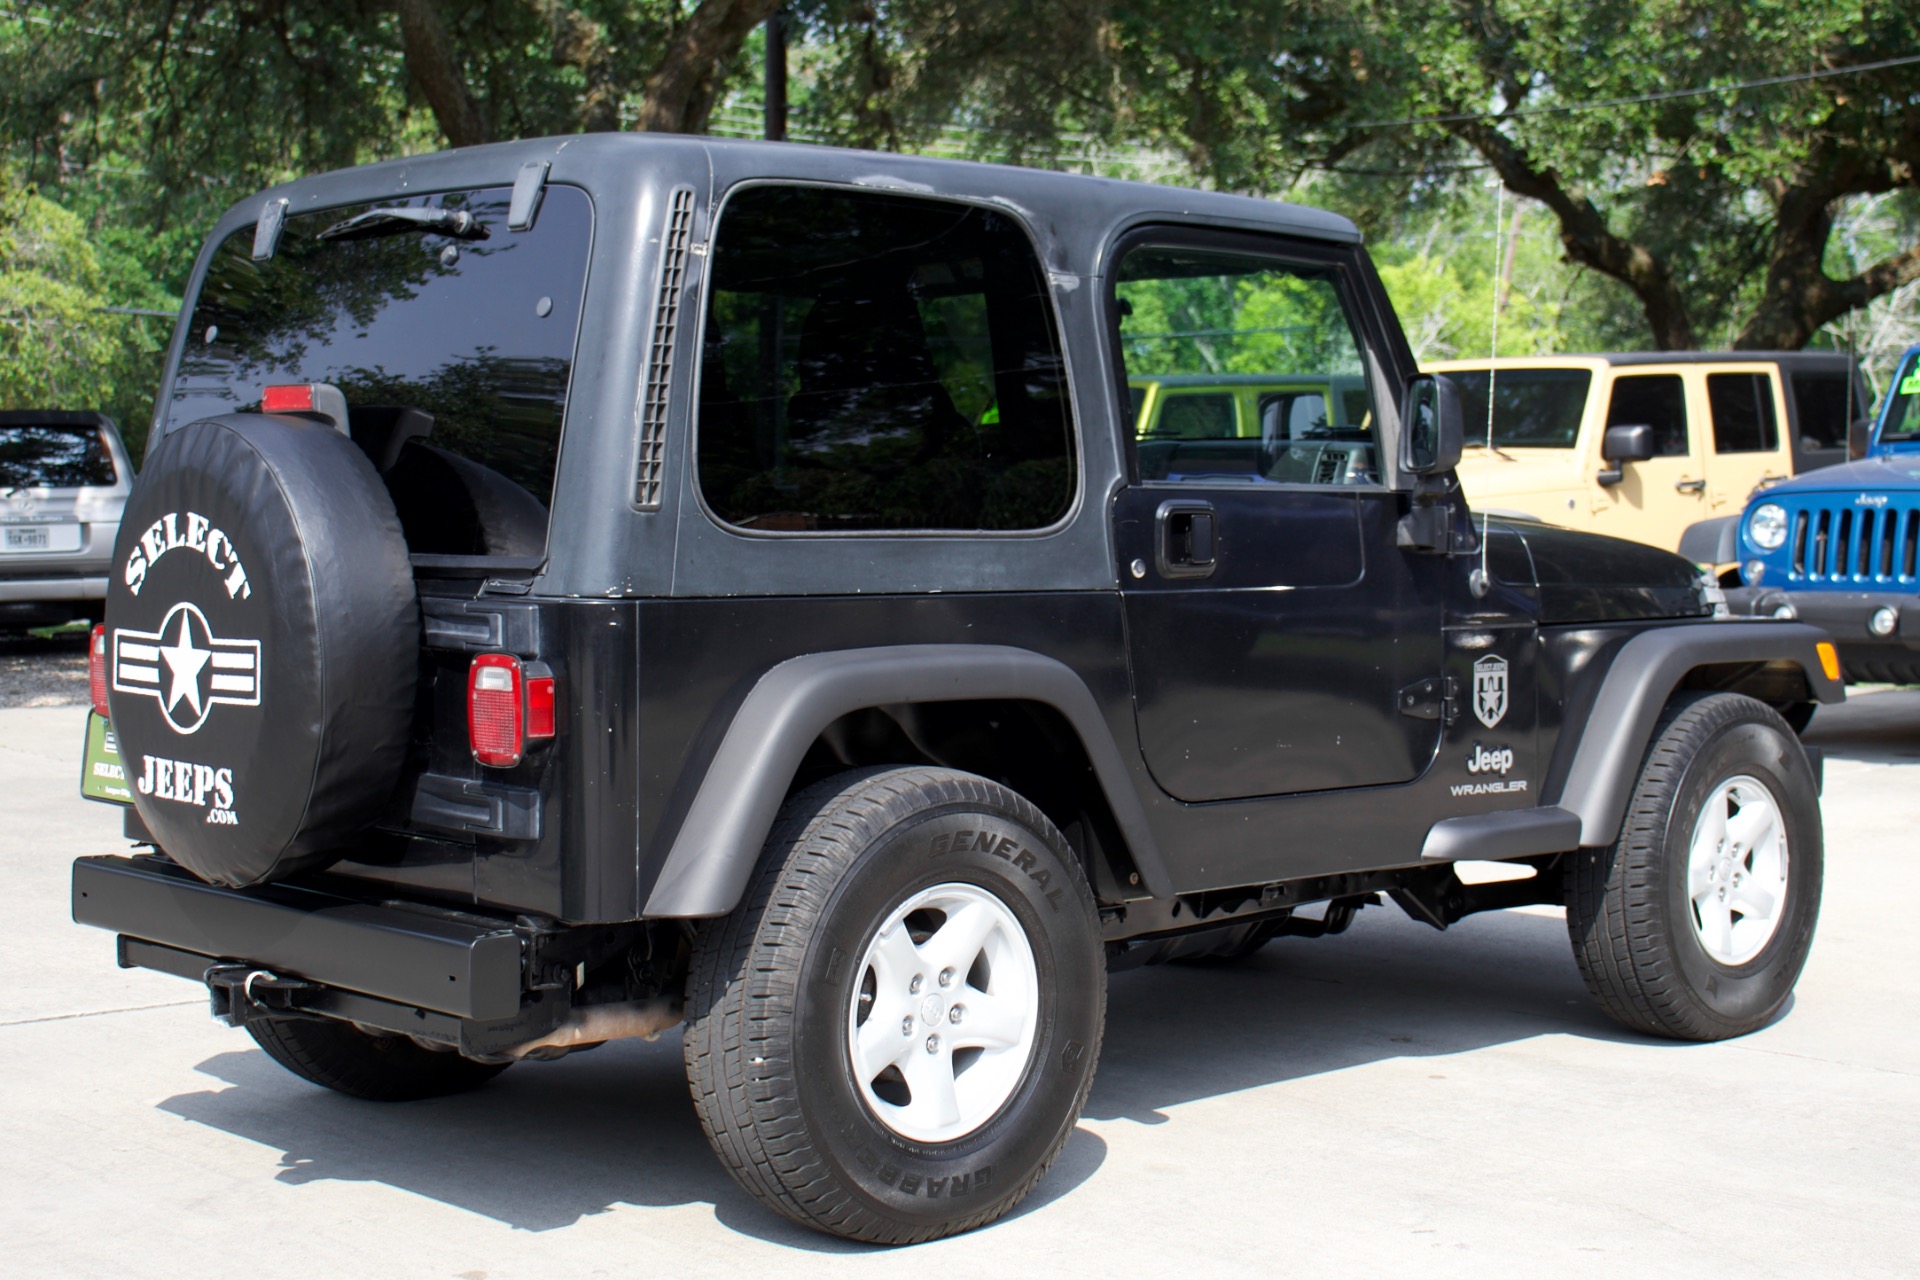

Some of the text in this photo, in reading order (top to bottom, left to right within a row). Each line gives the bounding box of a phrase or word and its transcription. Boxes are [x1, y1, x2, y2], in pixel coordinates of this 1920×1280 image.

[125, 511, 251, 600] SELECT
[1467, 745, 1513, 774] Jeep
[138, 754, 234, 810] JEEPS
[1450, 780, 1528, 796] WRANGLER
[205, 807, 239, 825] .COM
[928, 830, 1065, 913] GENERAL
